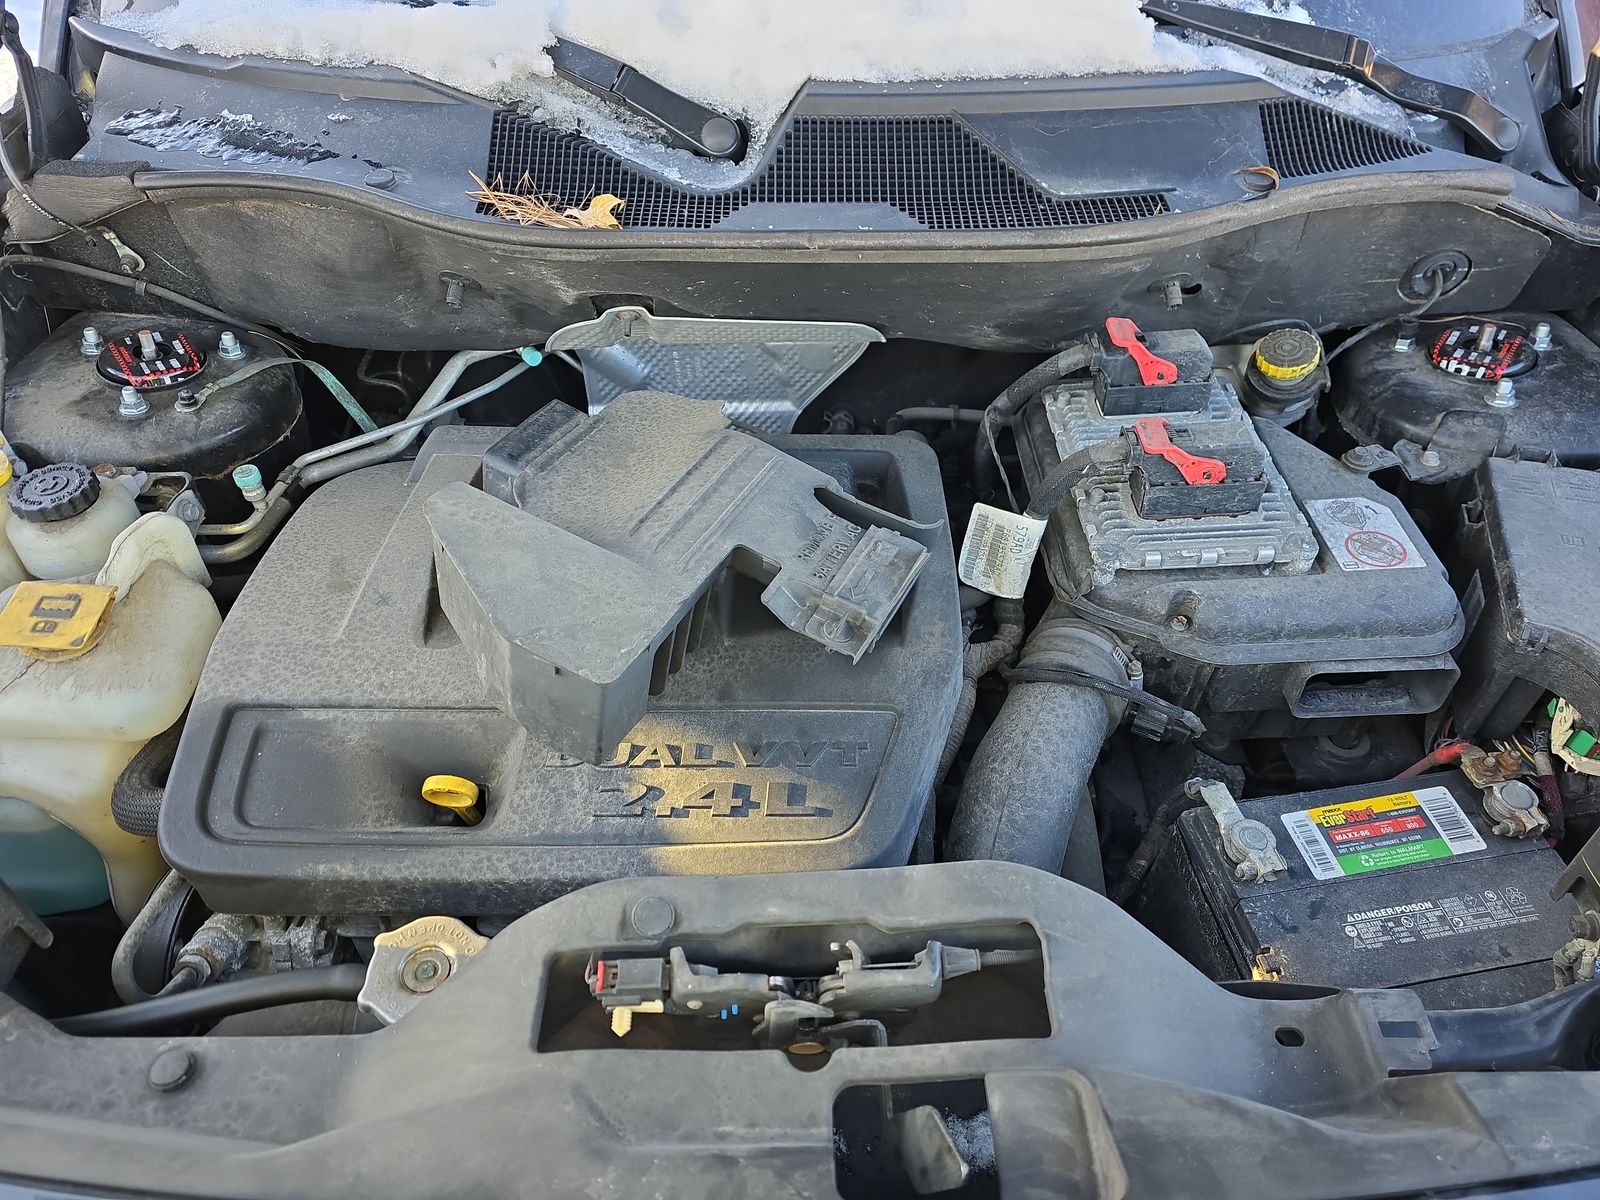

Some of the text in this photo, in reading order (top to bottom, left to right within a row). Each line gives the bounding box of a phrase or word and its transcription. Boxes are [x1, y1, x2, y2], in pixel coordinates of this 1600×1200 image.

[796, 522, 836, 564] REMOVE
[1010, 525, 1028, 553] 579AD
[812, 540, 849, 581] BATTERY
[733, 740, 870, 768] VVT
[594, 781, 816, 818] 2.4L
[1319, 807, 1375, 827] EverStart
[1405, 821, 1419, 829] 800
[1370, 850, 1390, 858] Return
[1395, 844, 1425, 853] WALMART
[1353, 901, 1434, 920] DANGER/POISON
